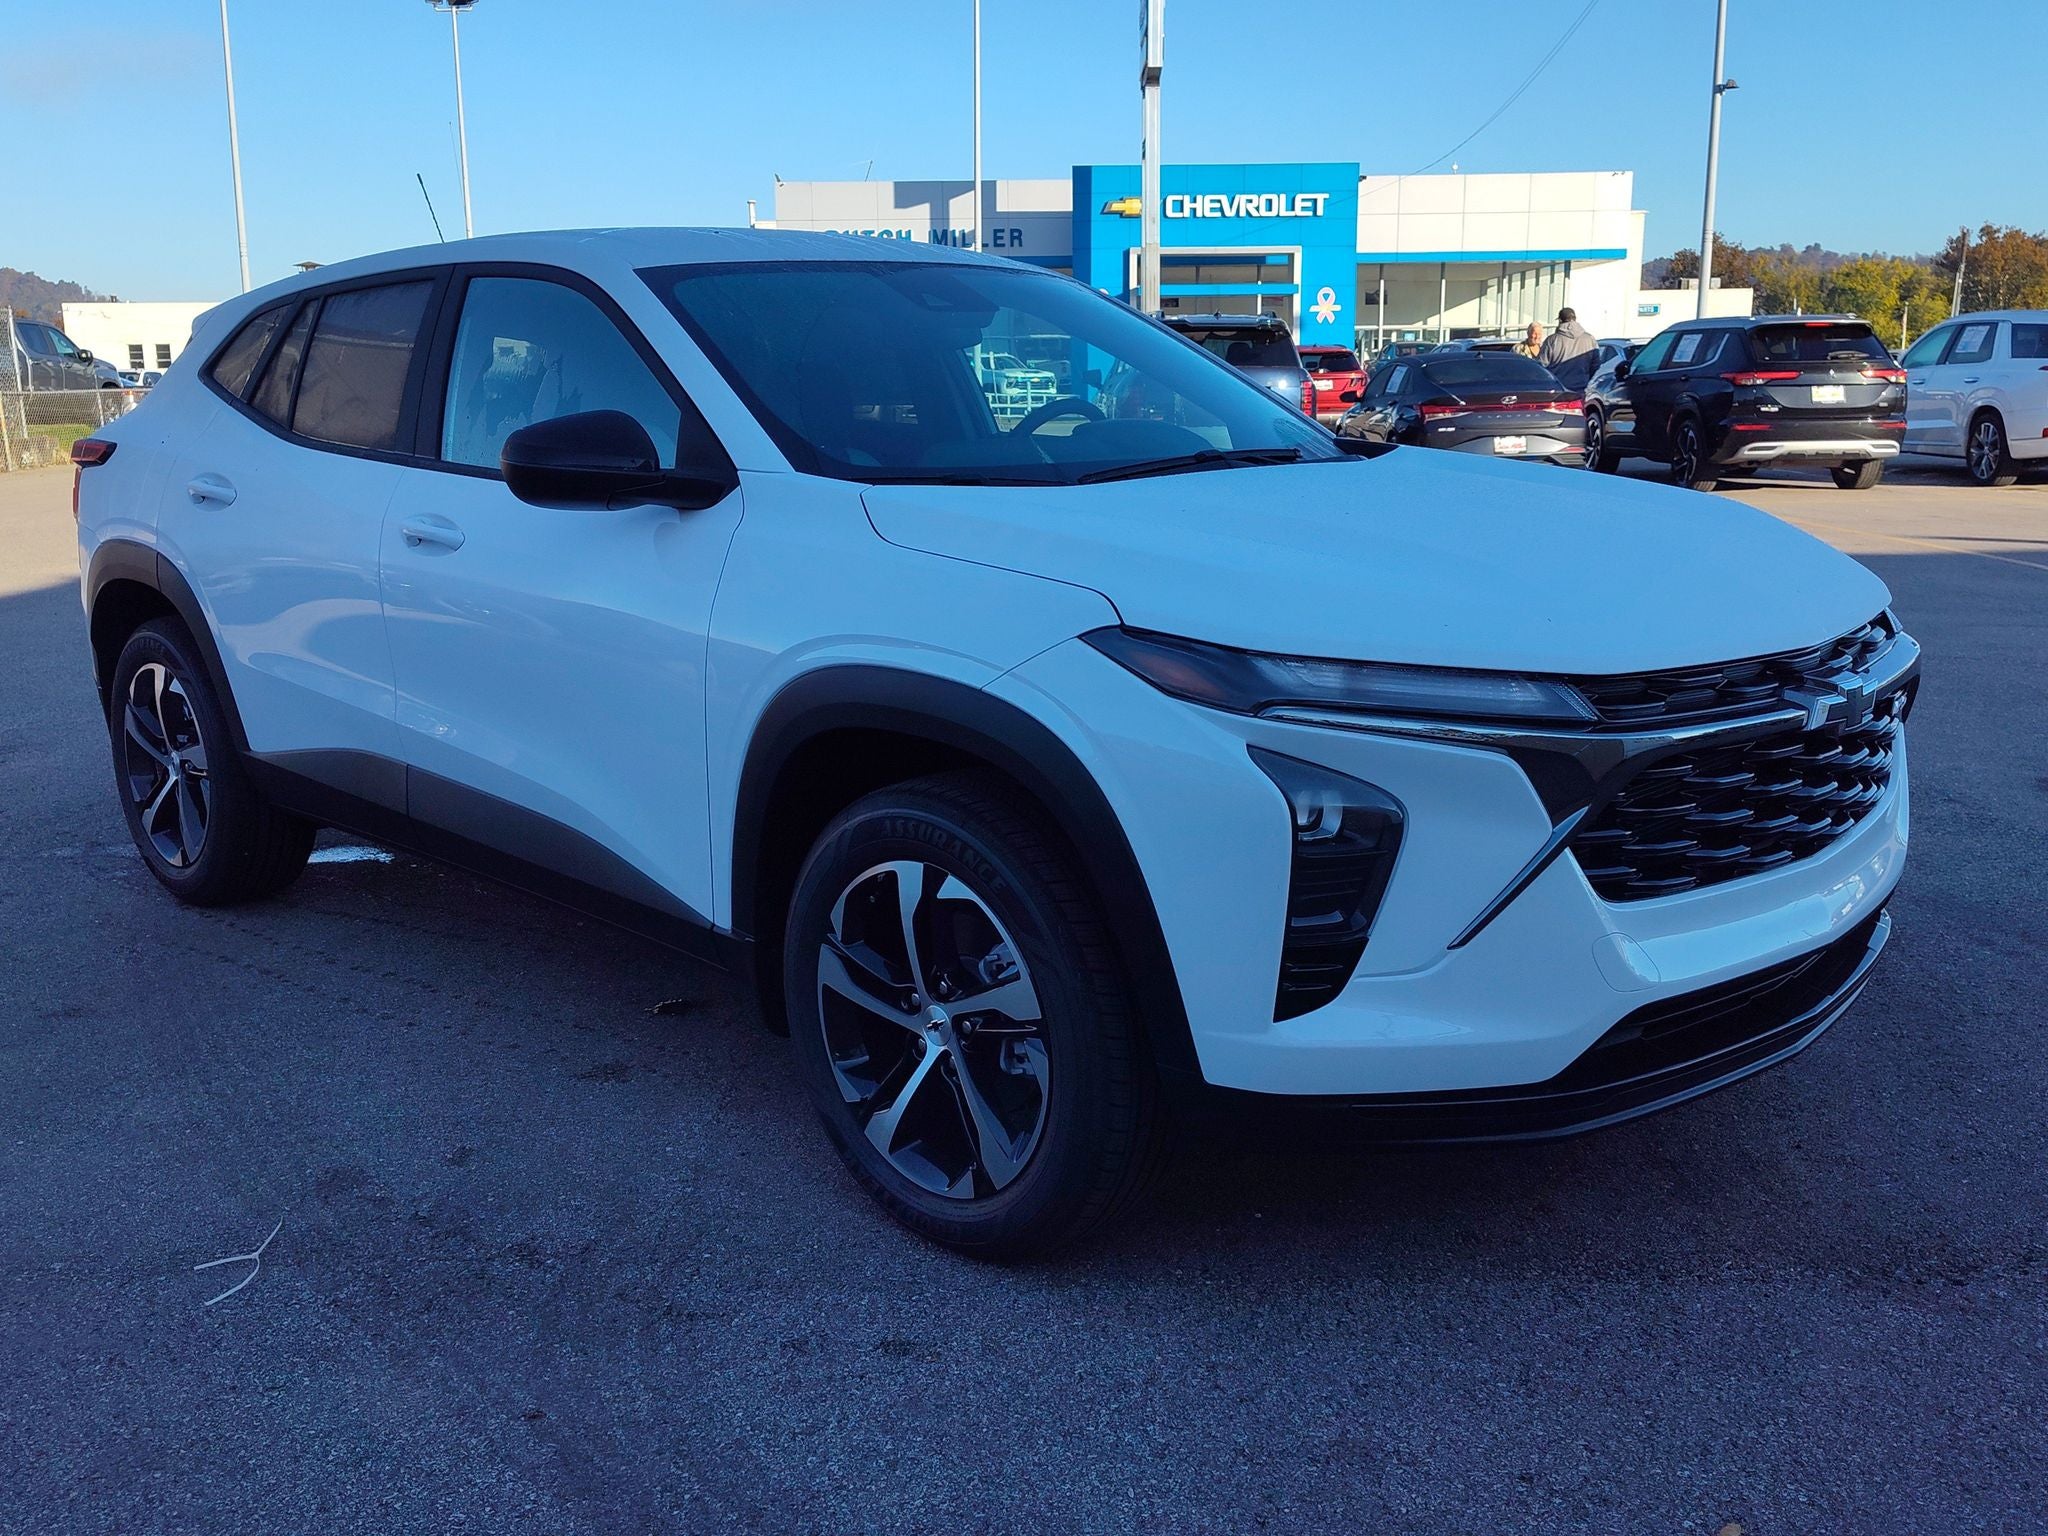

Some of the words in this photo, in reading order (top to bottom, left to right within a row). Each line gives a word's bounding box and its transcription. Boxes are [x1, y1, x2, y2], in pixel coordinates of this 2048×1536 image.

[1165, 194, 1330, 218] CHEVROLET
[929, 228, 1023, 248] MILER
[881, 818, 1008, 891] ASSURANCE
